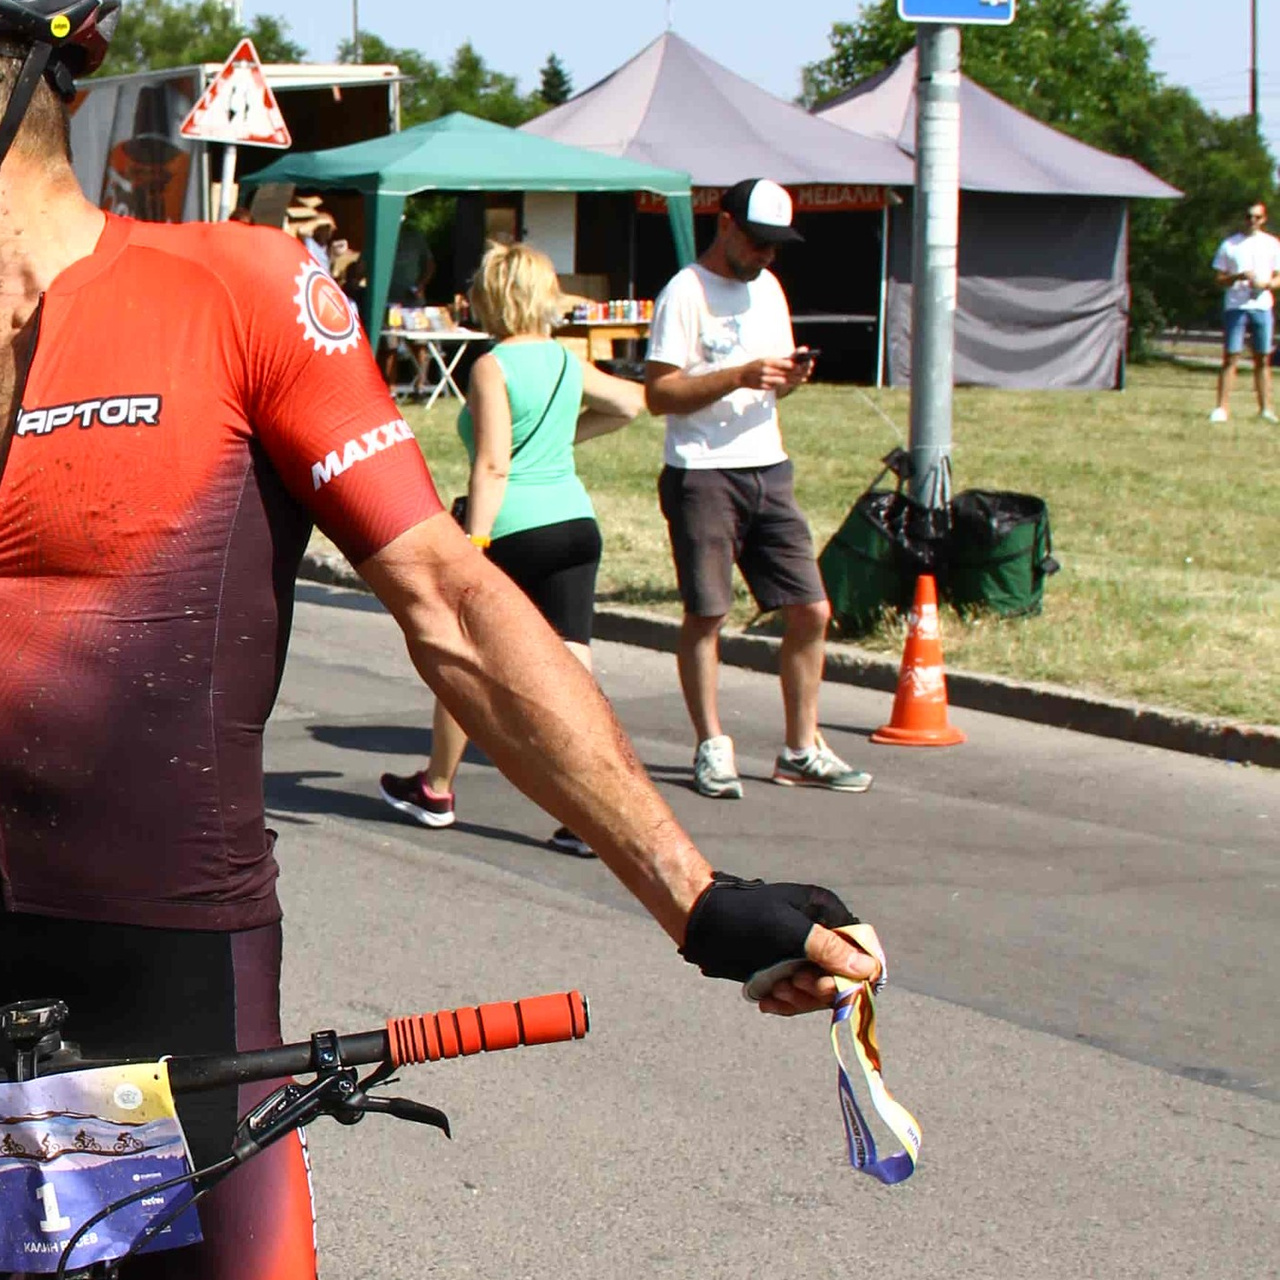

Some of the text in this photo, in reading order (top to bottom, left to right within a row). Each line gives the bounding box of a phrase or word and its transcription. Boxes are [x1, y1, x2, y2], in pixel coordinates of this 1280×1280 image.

[799, 186, 881, 206] МЕДАЛИ
[17, 397, 159, 436] APTOR
[311, 419, 415, 491] MAXXI
[36, 1182, 71, 1232] 1
